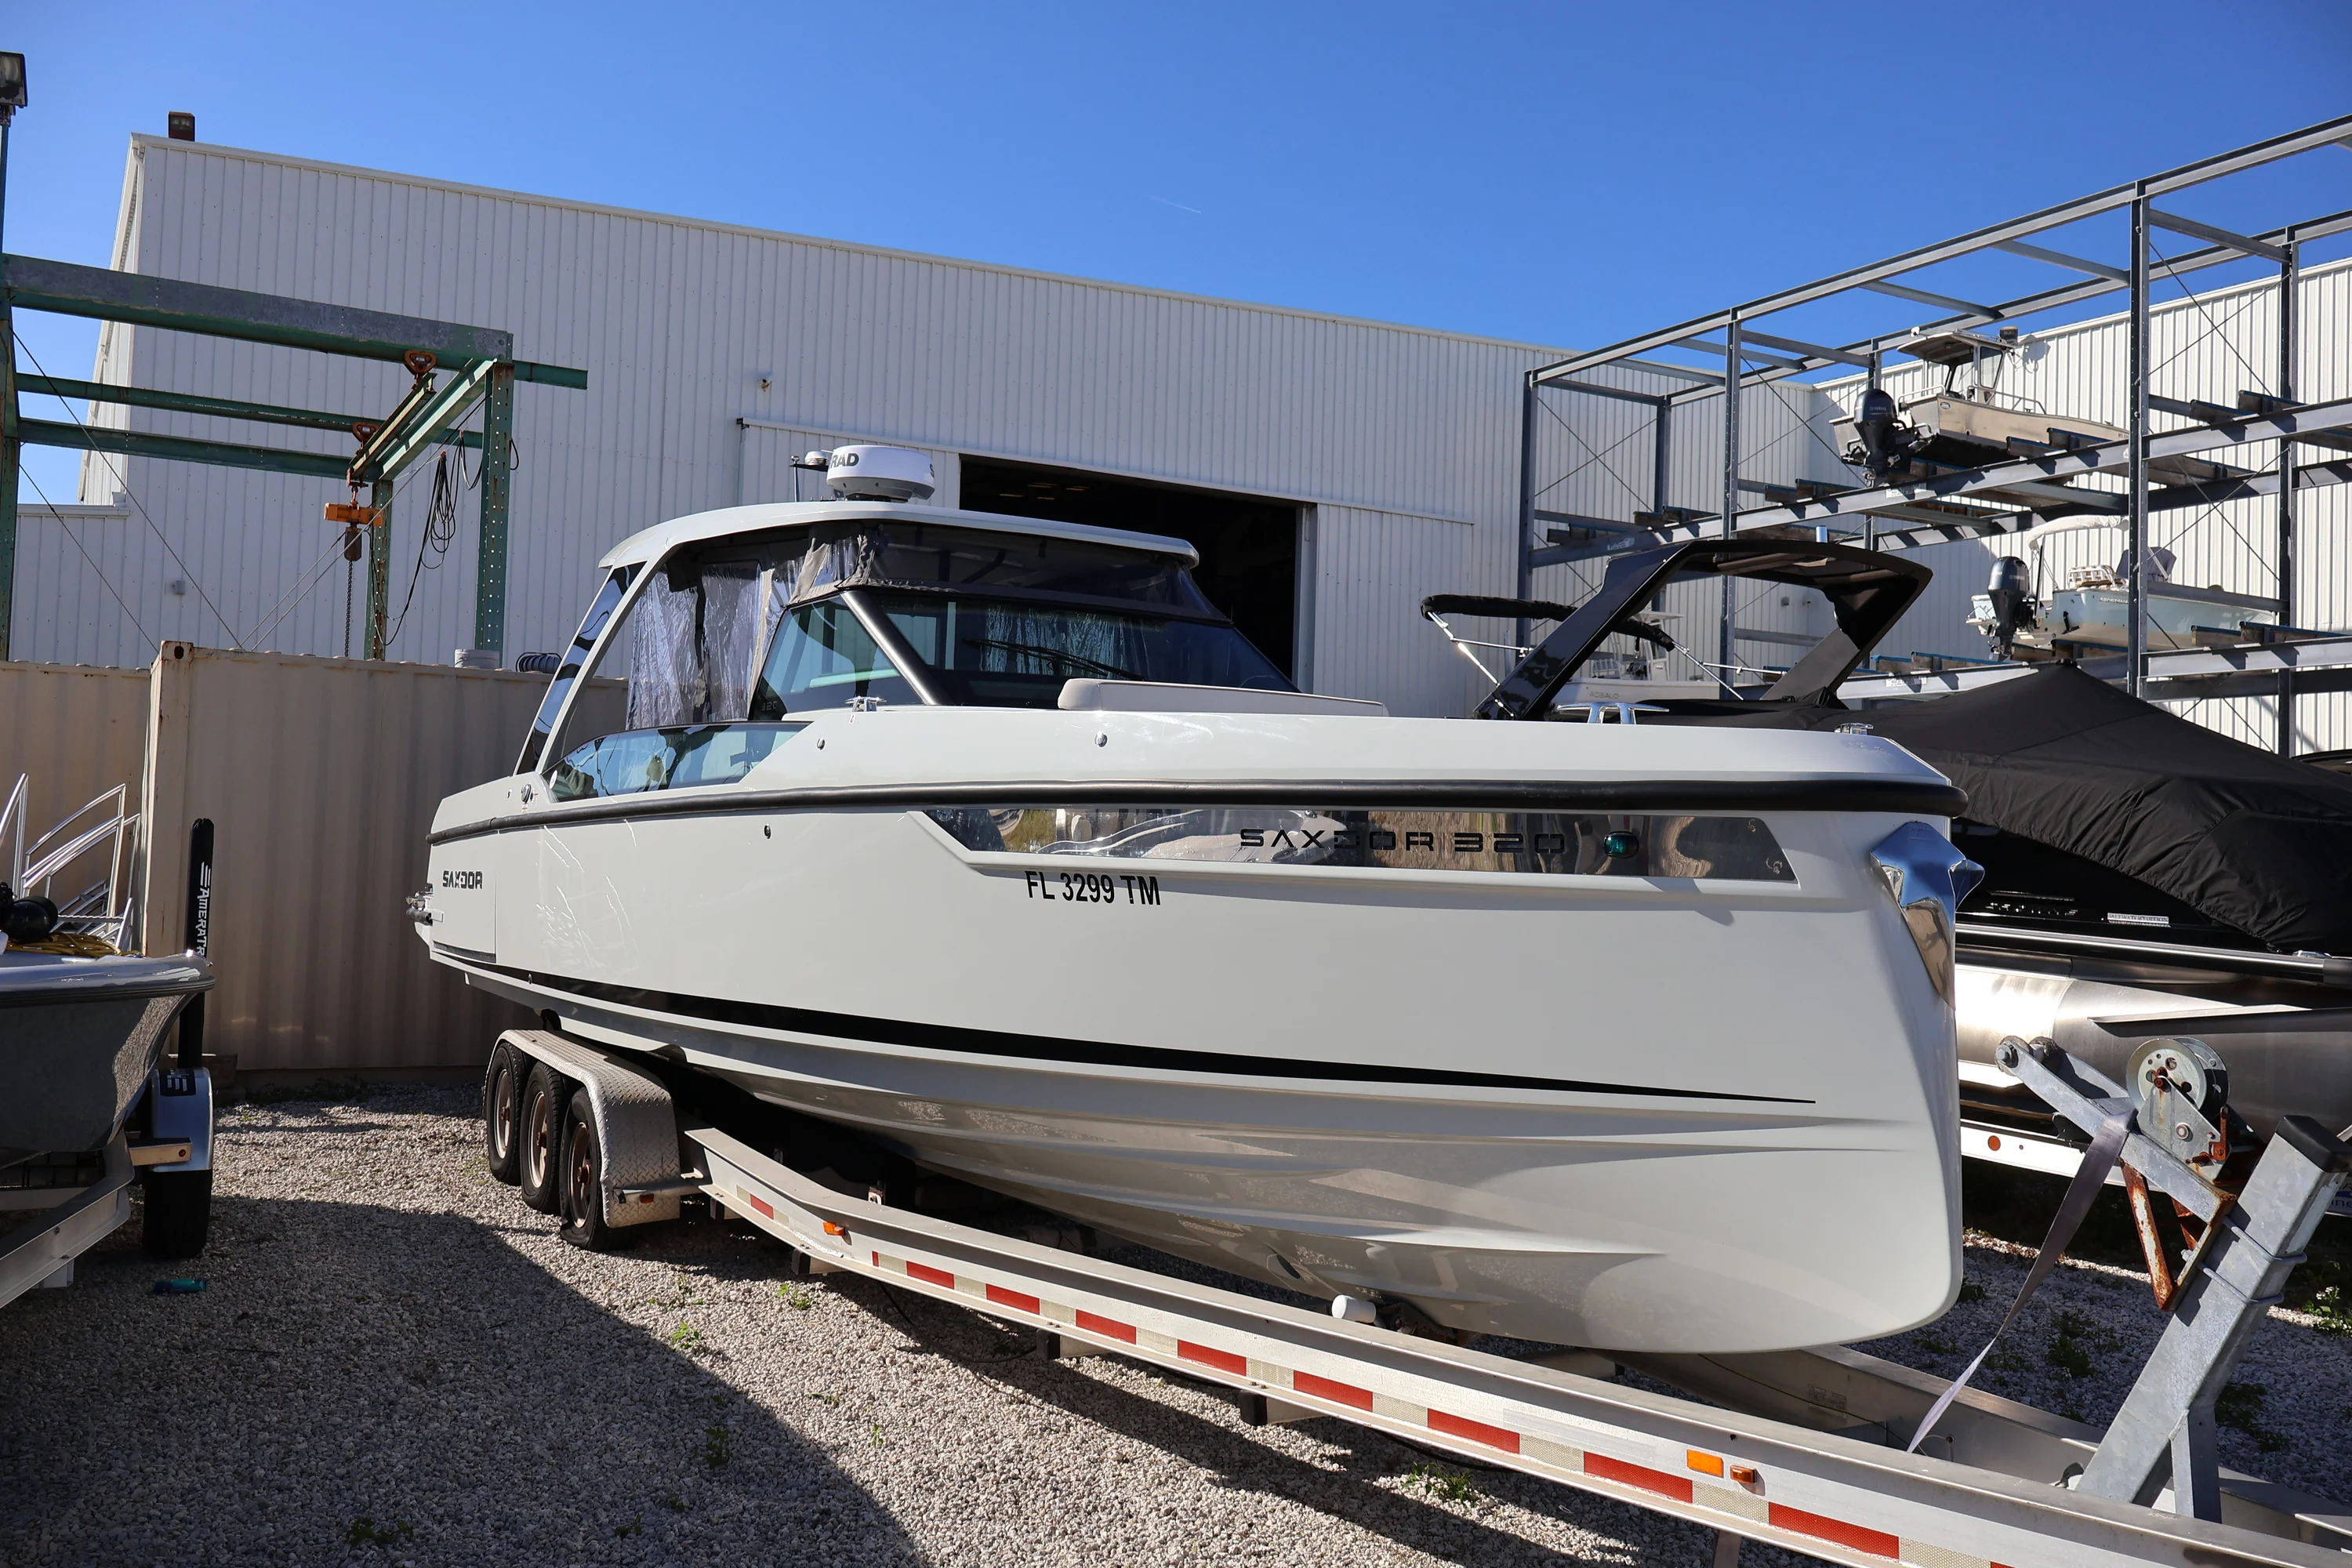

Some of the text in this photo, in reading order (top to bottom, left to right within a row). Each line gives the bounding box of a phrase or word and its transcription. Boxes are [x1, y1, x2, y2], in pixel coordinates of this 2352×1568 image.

[831, 452, 859, 468] RAD
[1240, 829, 1566, 854] SAXDOR 320
[442, 870, 483, 890] SAXDOR
[1025, 870, 1160, 905] FL 3299 TM
[195, 887, 210, 956] AMERATR
